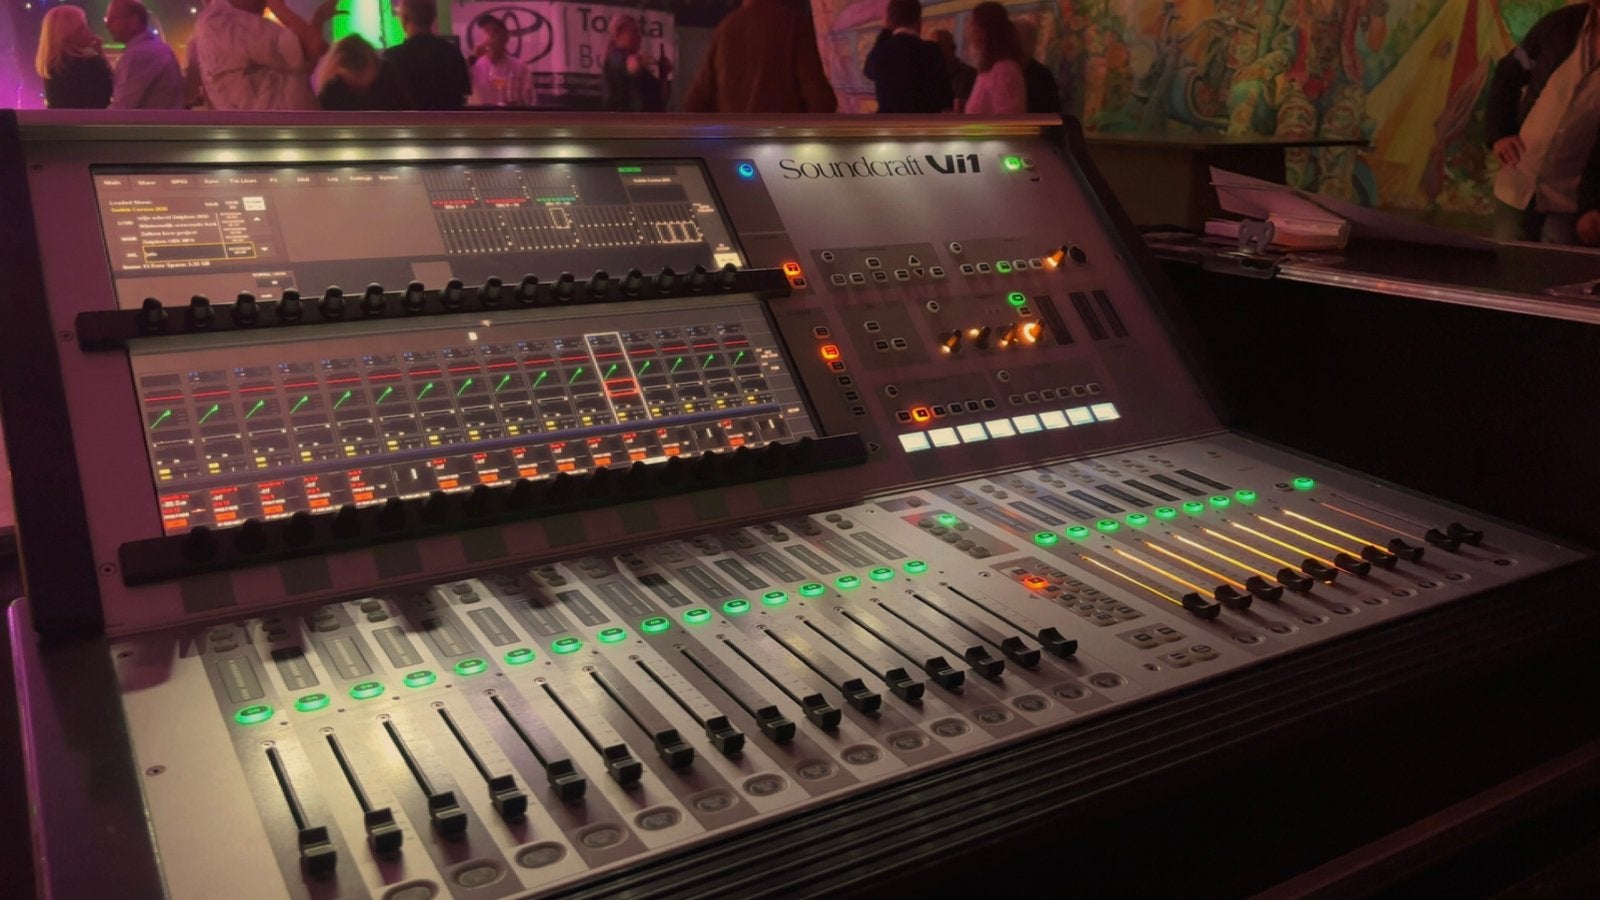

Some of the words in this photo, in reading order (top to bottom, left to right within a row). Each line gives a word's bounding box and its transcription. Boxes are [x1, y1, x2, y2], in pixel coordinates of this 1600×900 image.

[577, 8, 663, 38] Tota
[779, 156, 924, 180] Soundcraft
[925, 154, 981, 174] Vi1
